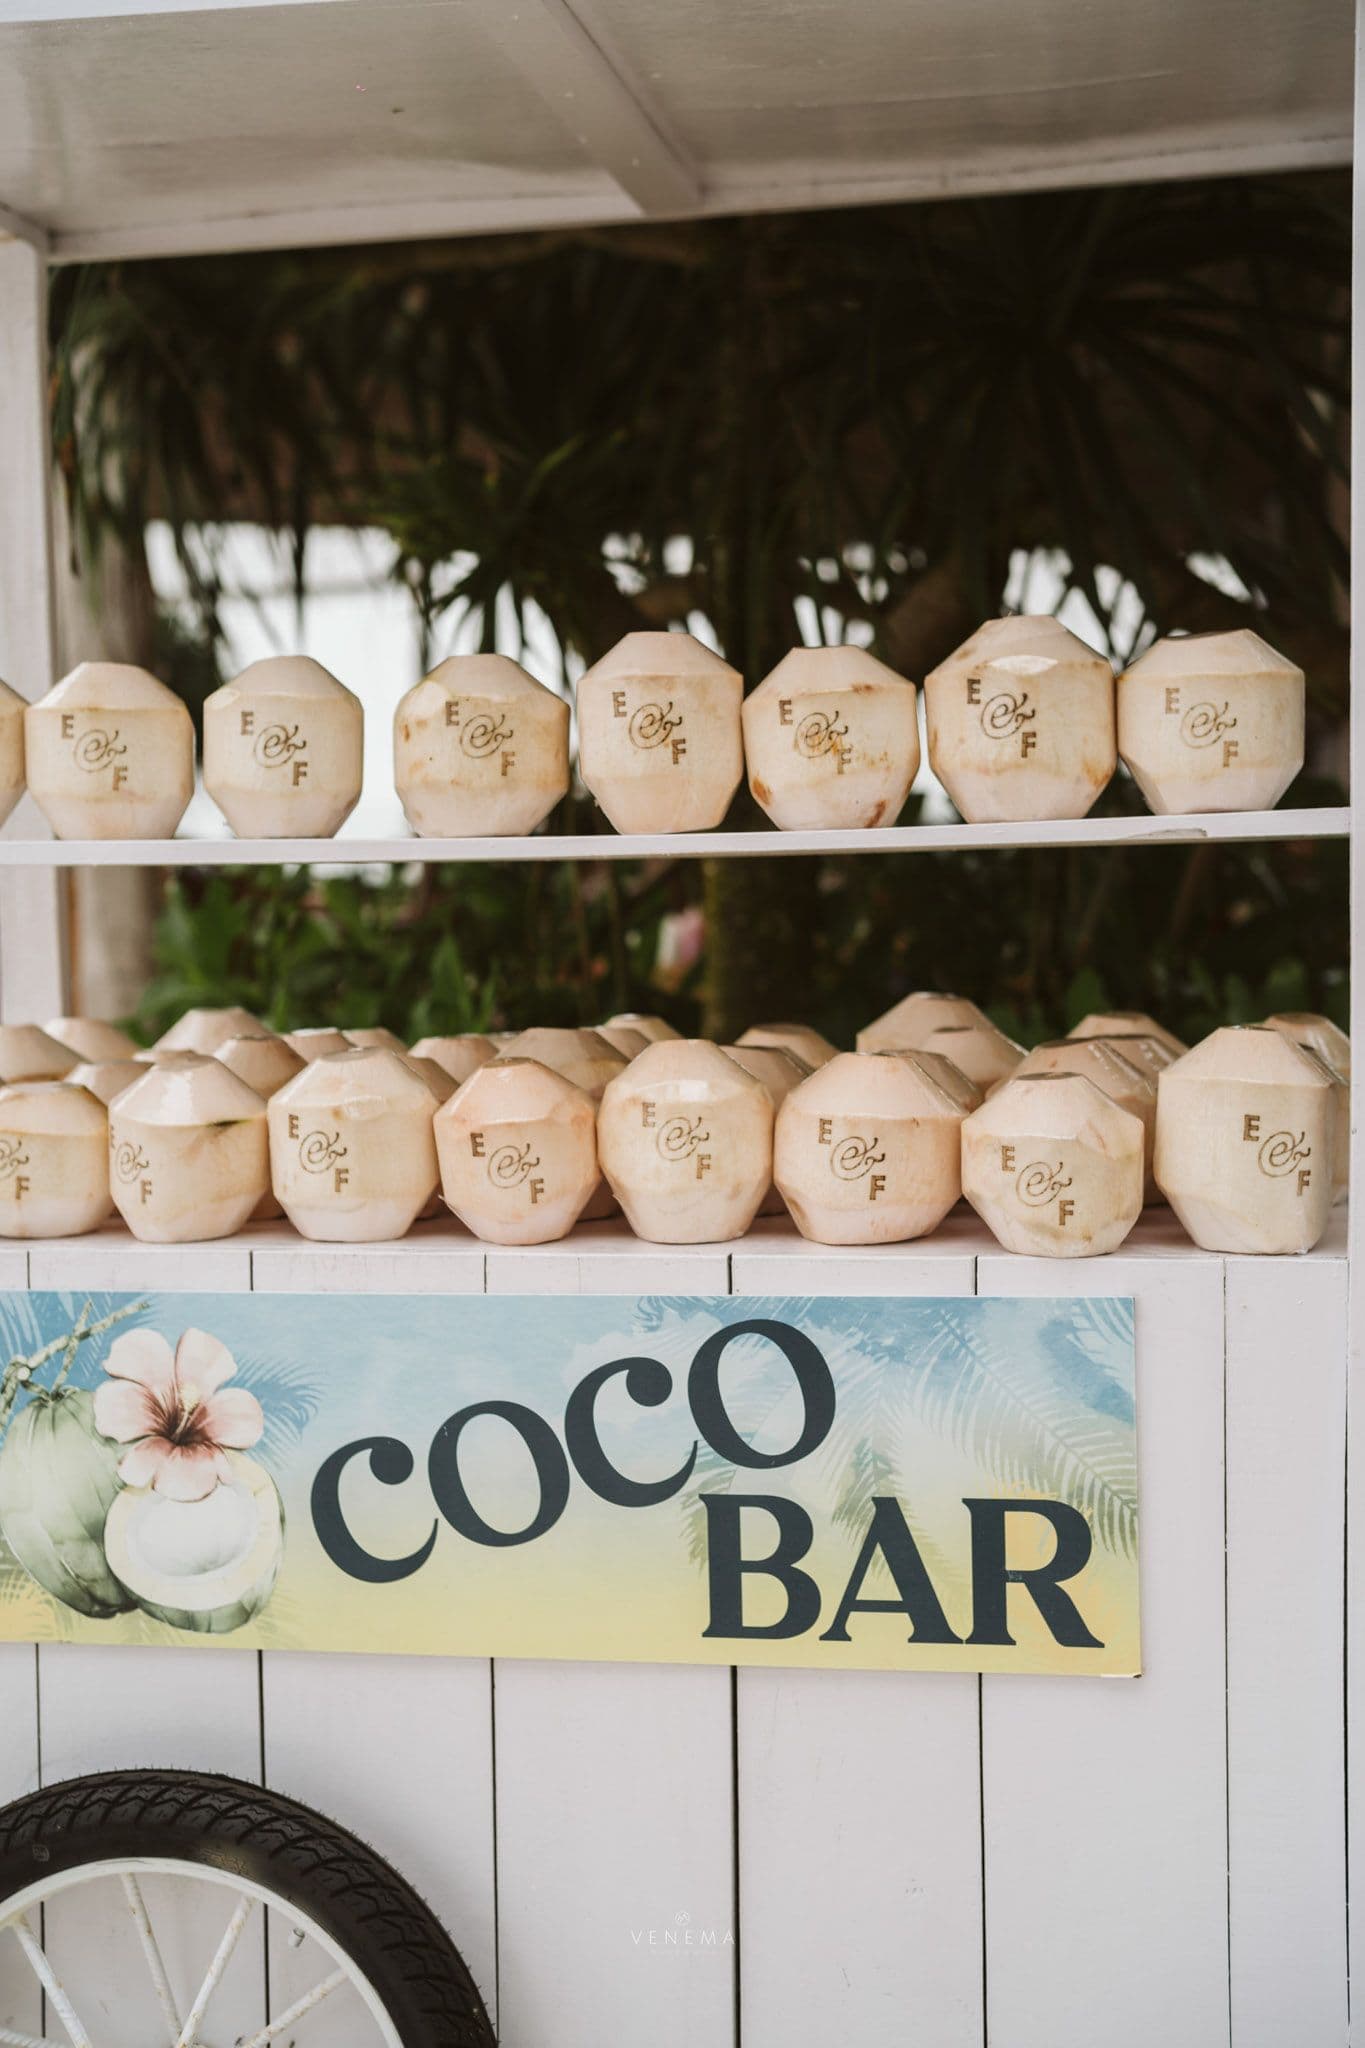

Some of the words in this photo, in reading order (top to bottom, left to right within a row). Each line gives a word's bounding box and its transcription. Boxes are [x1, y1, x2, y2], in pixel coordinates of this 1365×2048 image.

[61, 714, 74, 739] E
[112, 766, 129, 791] F
[241, 711, 254, 736] E
[292, 761, 308, 786] F
[445, 701, 459, 726] E
[501, 751, 515, 776] F
[612, 691, 627, 717] E
[671, 738, 686, 764] F
[778, 700, 793, 725] E
[837, 745, 853, 775] F
[966, 678, 981, 705] E
[1021, 732, 1037, 758] F
[1165, 688, 1180, 714] E
[1222, 740, 1239, 768] F
[288, 1114, 299, 1140] E
[335, 1168, 349, 1193] F
[470, 1132, 486, 1157] E
[529, 1178, 545, 1204] F
[642, 1102, 656, 1128] E
[696, 1154, 712, 1180] F
[818, 1118, 832, 1145] E
[869, 1175, 887, 1200] F
[1243, 1114, 1260, 1142] E
[1296, 1169, 1311, 1197] F
[15, 1176, 30, 1200] F
[140, 1179, 152, 1204] F
[1001, 1146, 1016, 1172] E
[1058, 1200, 1075, 1226] F
[310, 1318, 837, 1584] COCO
[699, 1493, 1106, 1648] BAR
